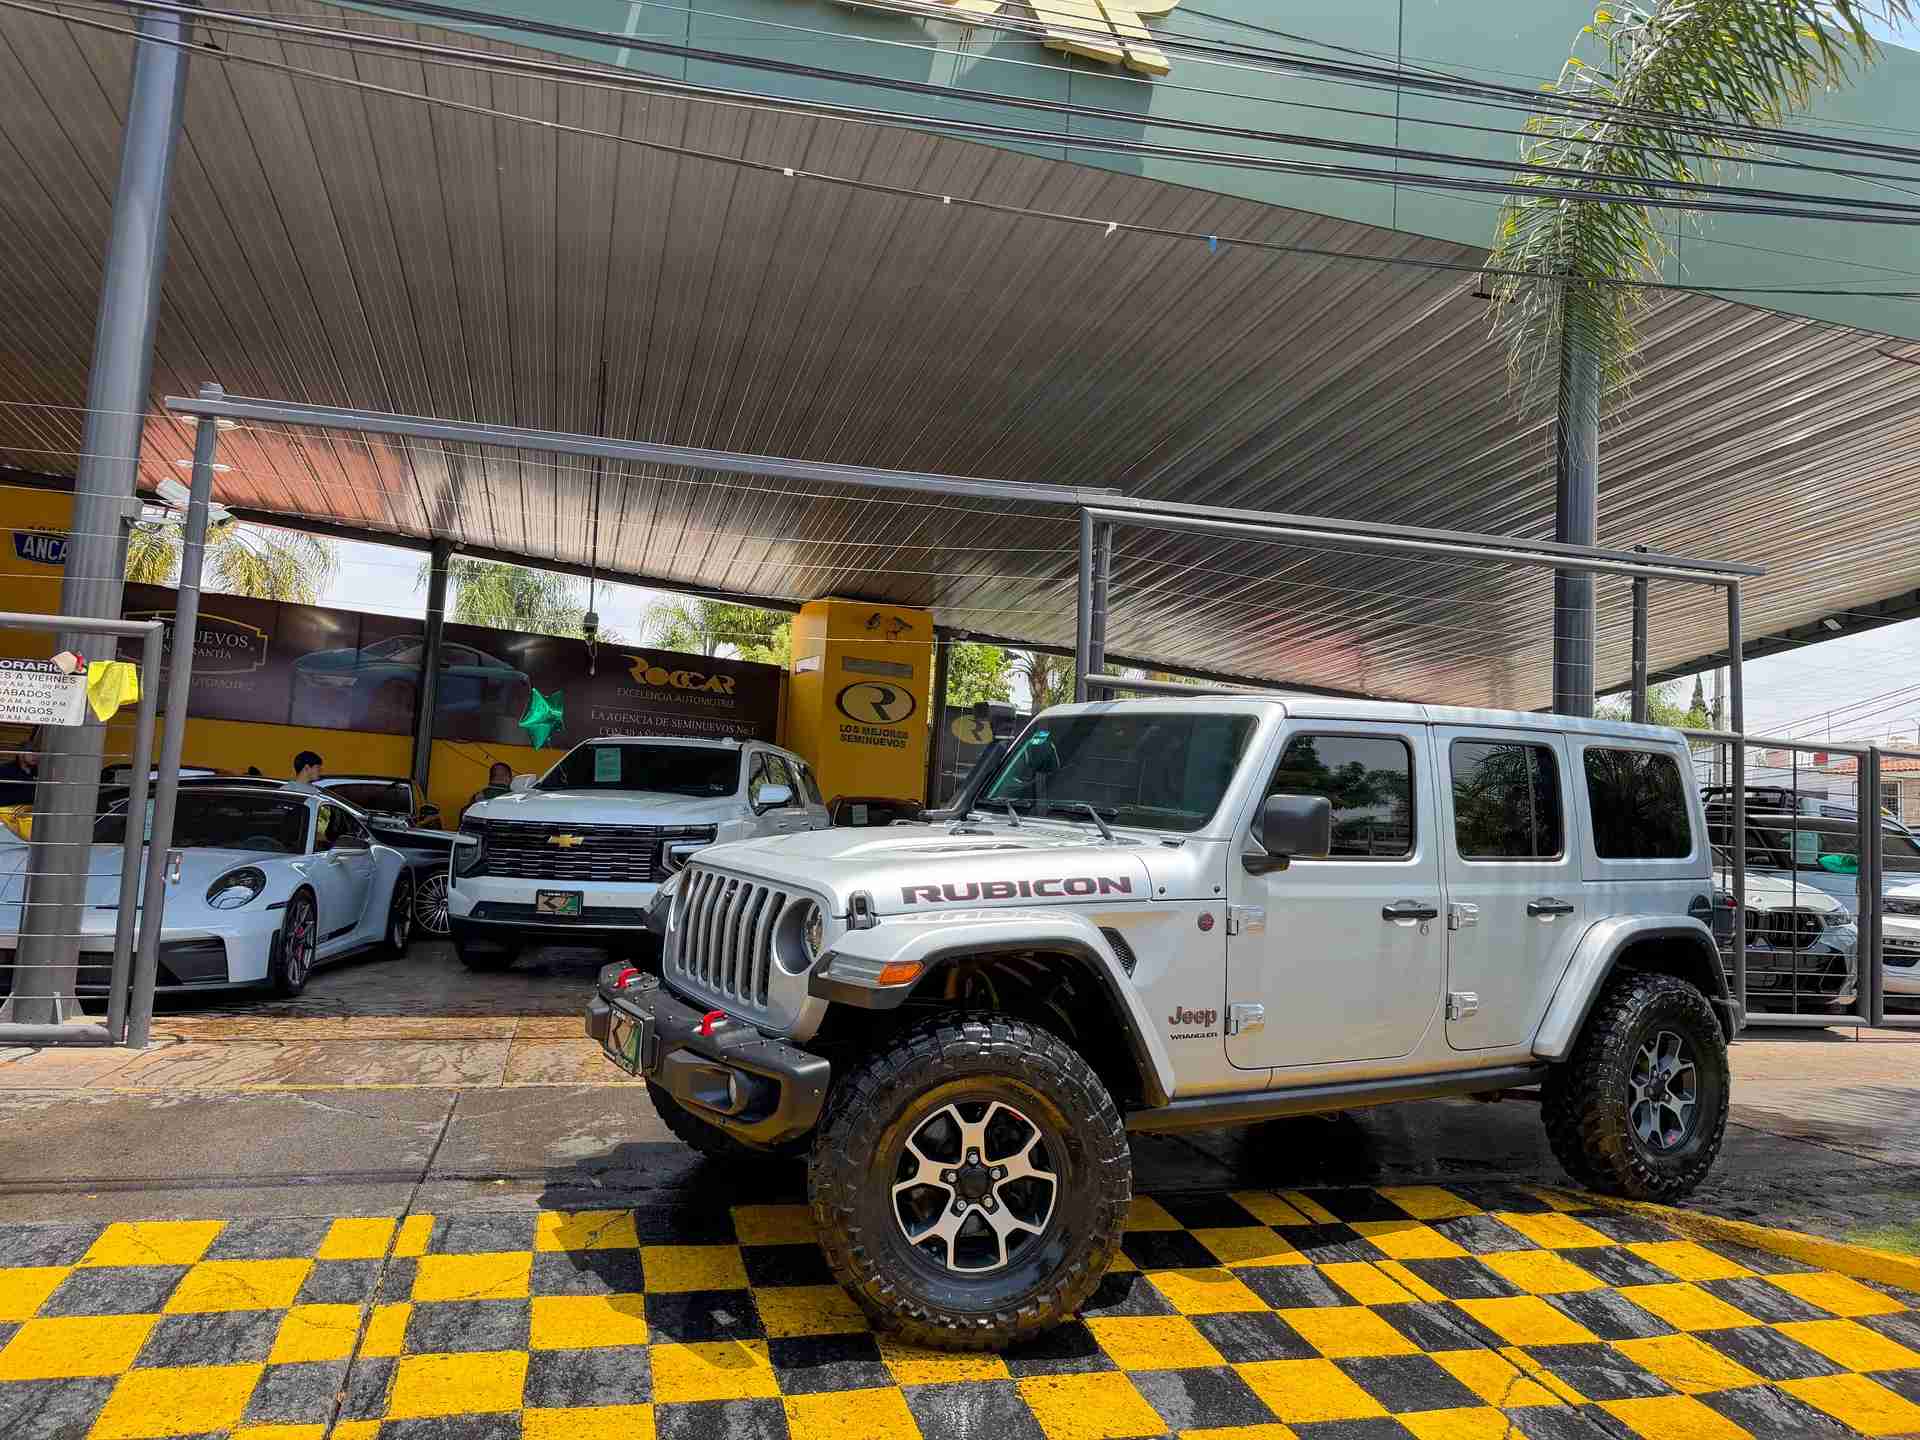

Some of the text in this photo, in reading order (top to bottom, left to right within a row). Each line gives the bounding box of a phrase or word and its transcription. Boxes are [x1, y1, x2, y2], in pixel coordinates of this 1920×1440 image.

[28, 674, 76, 685] VIERNES
[655, 714, 668, 727] DE
[839, 724, 860, 733] LOS
[839, 733, 907, 749] SEMINUEVOS
[901, 876, 1133, 905] RUBICON
[1168, 1006, 1218, 1028] Jeep
[1169, 1031, 1218, 1041] WRANGLER
